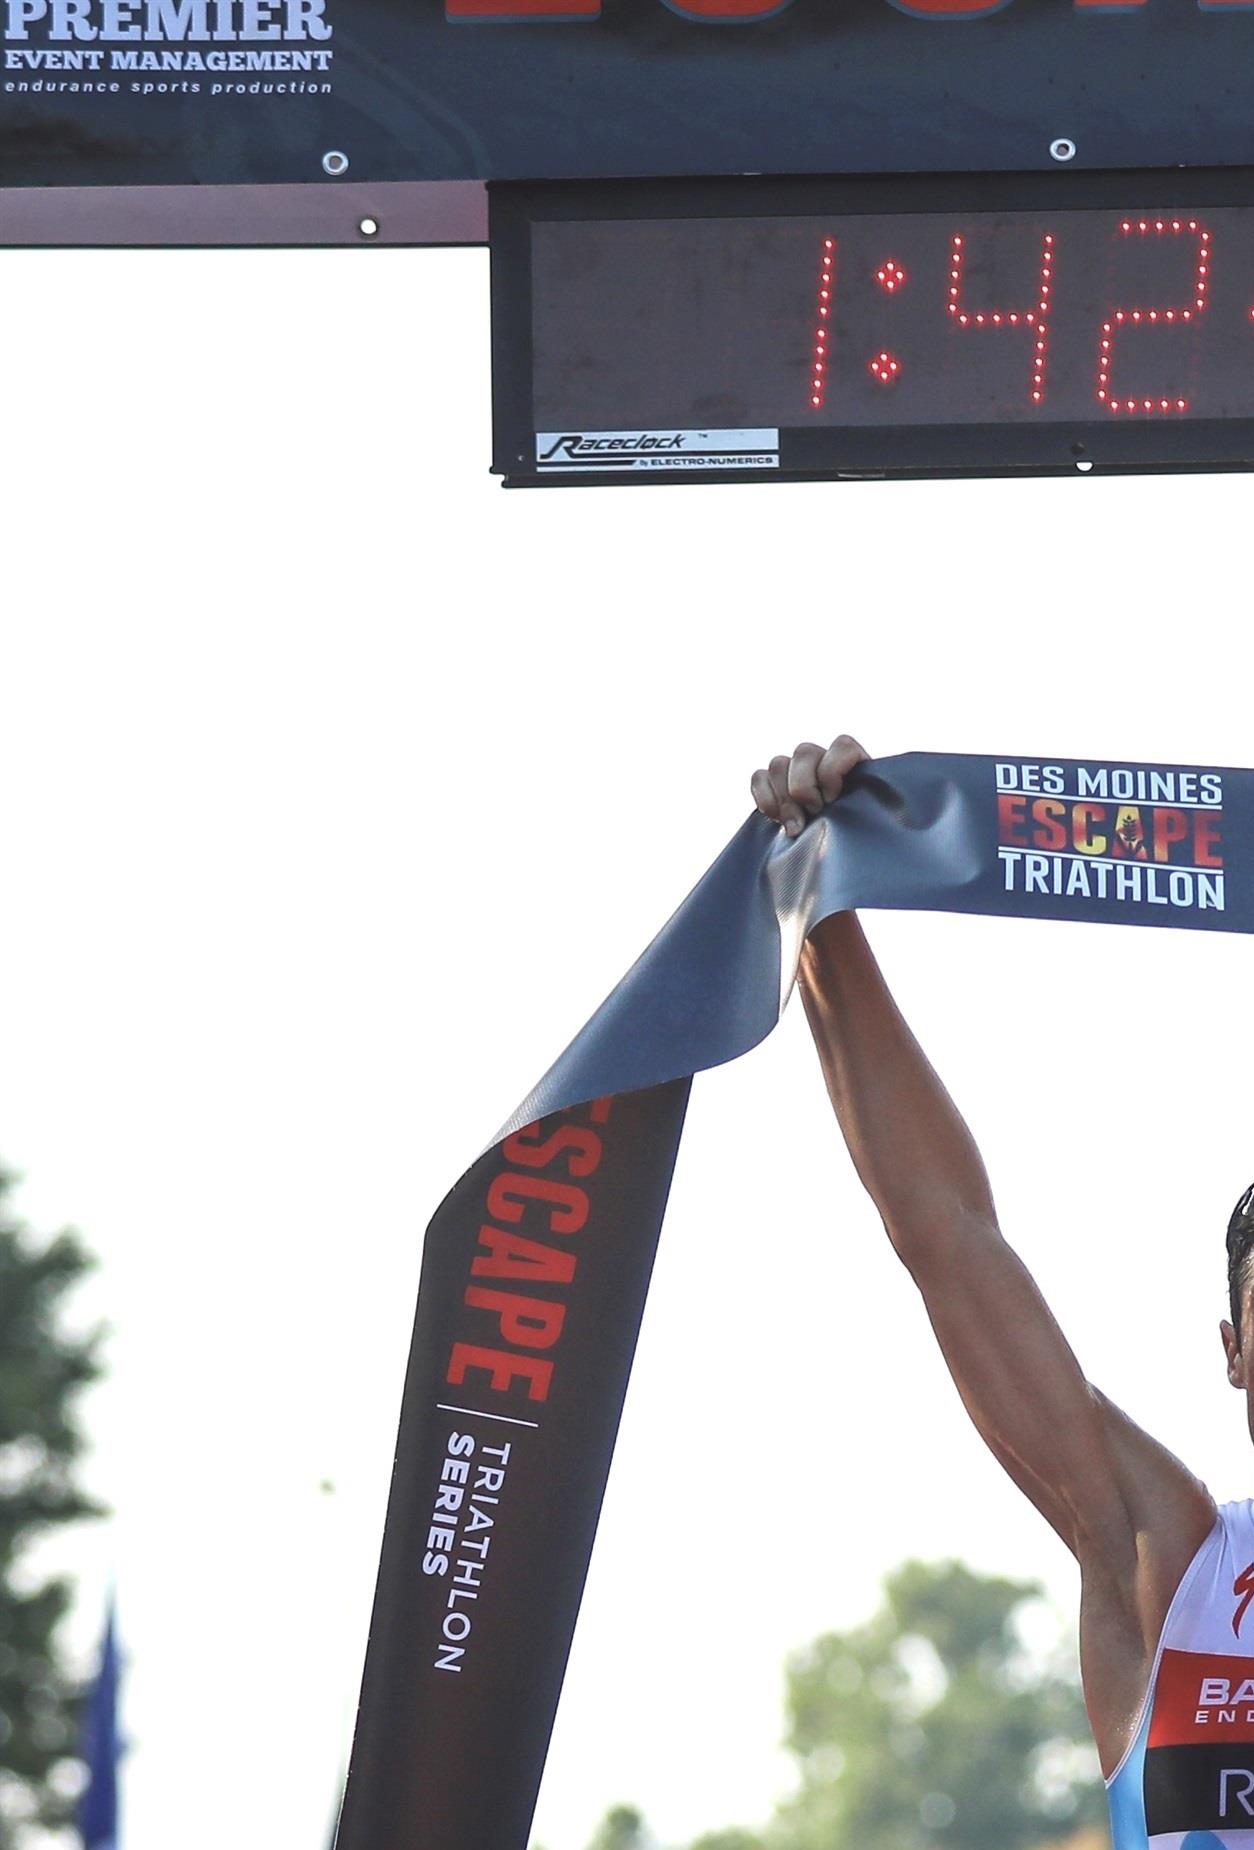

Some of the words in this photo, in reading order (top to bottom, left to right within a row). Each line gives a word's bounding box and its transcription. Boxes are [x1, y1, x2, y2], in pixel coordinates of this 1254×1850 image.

[4, 0, 333, 41] PREMIER
[5, 50, 104, 70] EVENT
[111, 51, 333, 71] MANAGEMENT
[5, 80, 120, 93] endurance
[131, 82, 200, 95] sports
[212, 81, 333, 95] production
[539, 434, 686, 459] Raceclock
[651, 457, 773, 466] ELECTRO-NUMERICS
[995, 763, 1065, 794] DES
[1077, 768, 1222, 804] MOINES
[996, 795, 1224, 868] ESCAPE
[998, 852, 1225, 911] TRIATHLON
[422, 1431, 476, 1578] SERIES
[434, 1442, 512, 1673] TRIATHLON
